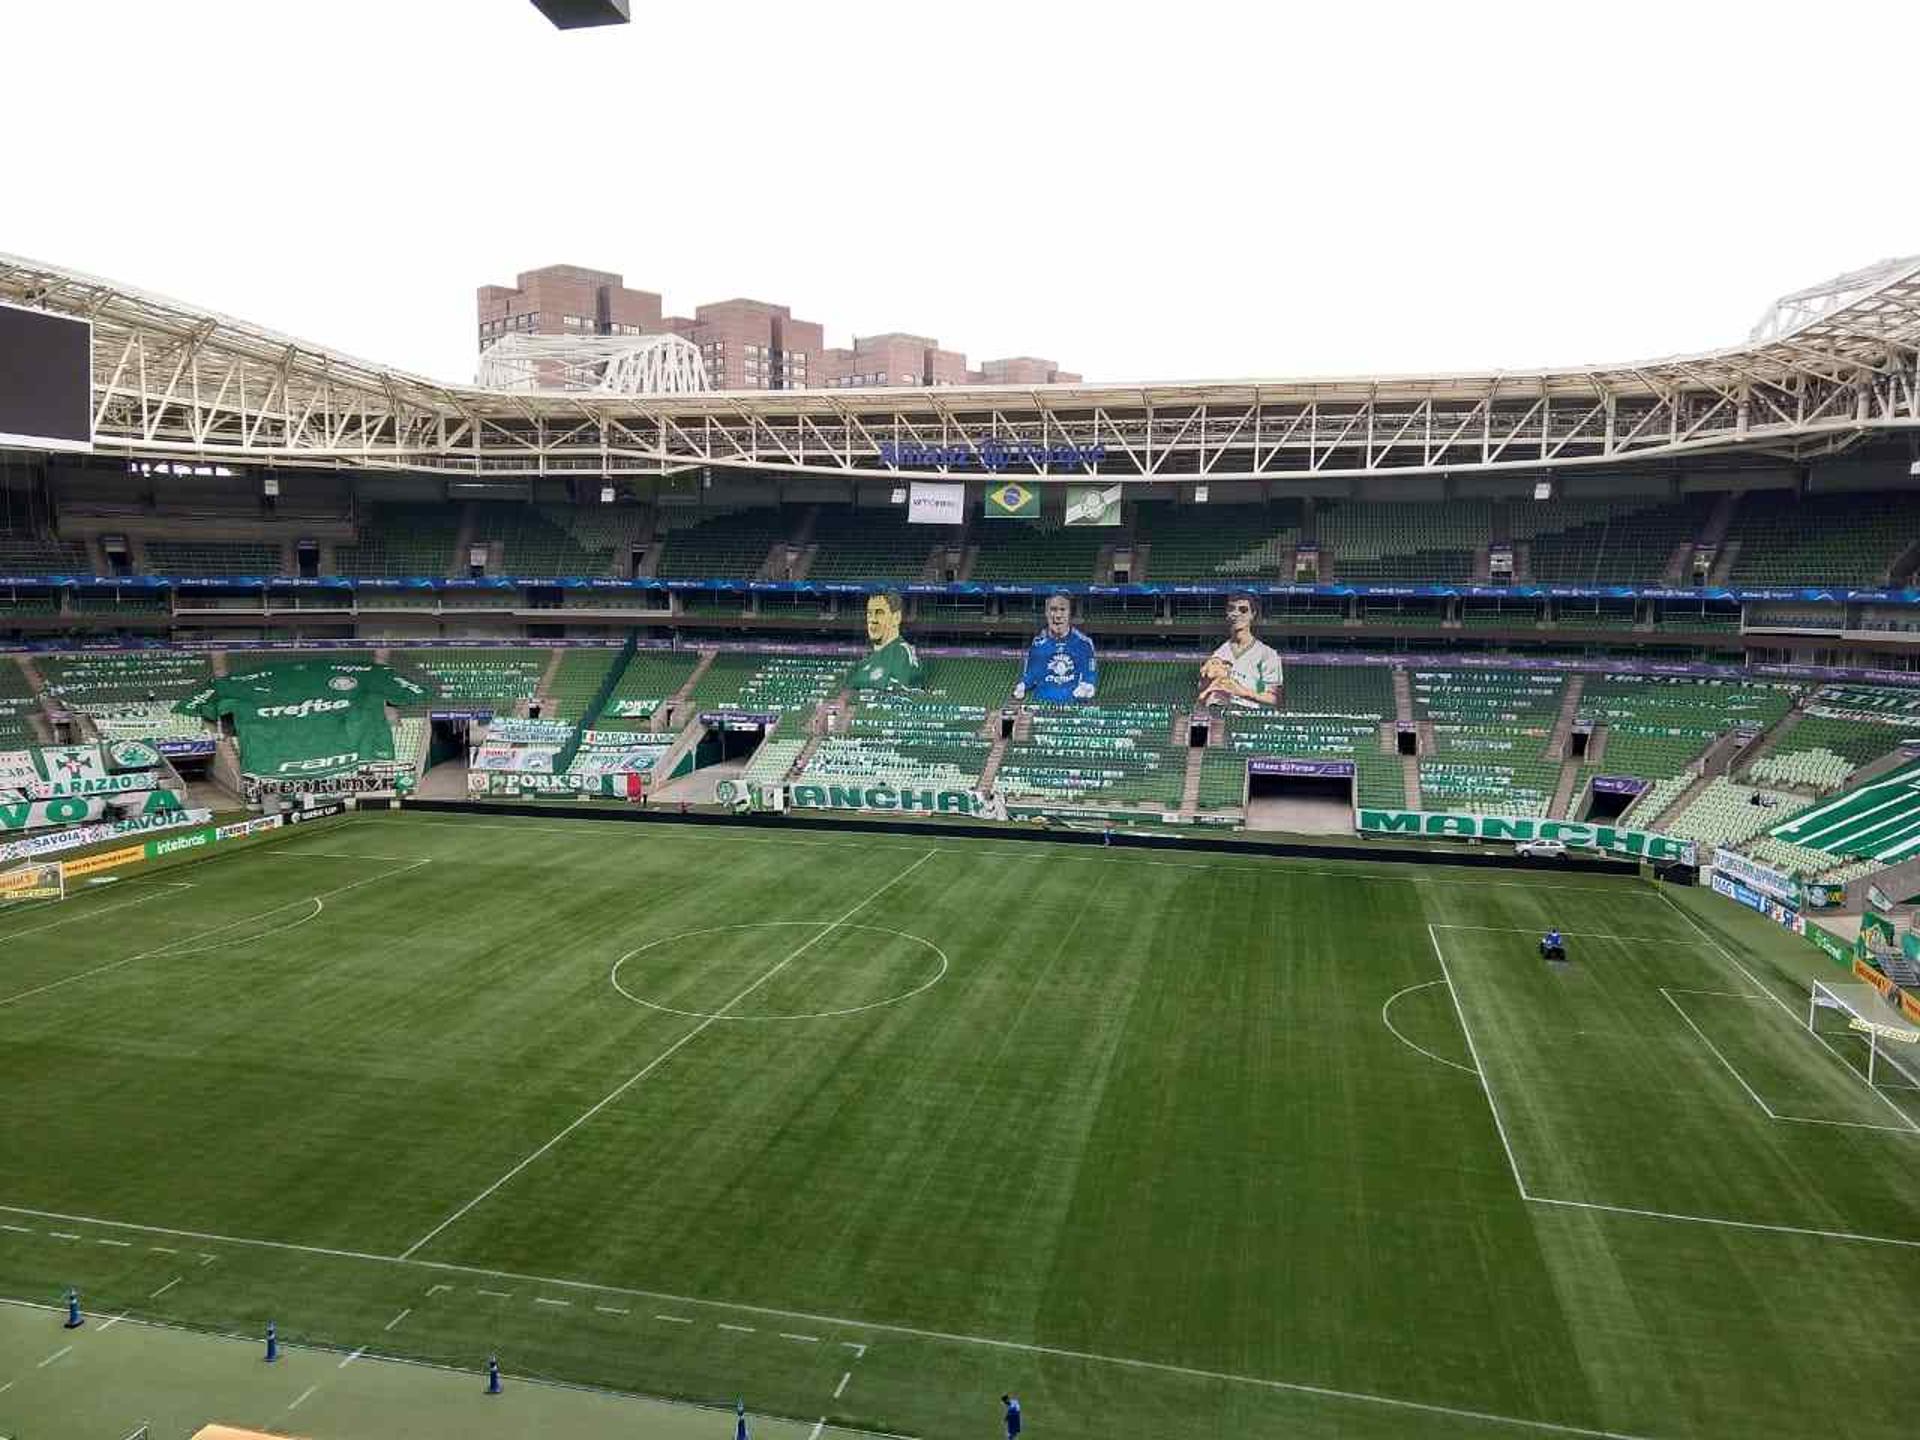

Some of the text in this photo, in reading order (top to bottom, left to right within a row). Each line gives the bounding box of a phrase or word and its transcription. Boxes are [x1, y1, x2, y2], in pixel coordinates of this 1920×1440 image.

[257, 699, 350, 718] crefisa
[506, 774, 582, 788] PORK'S
[33, 829, 80, 848] SAVOIA
[157, 834, 207, 855] intelbras
